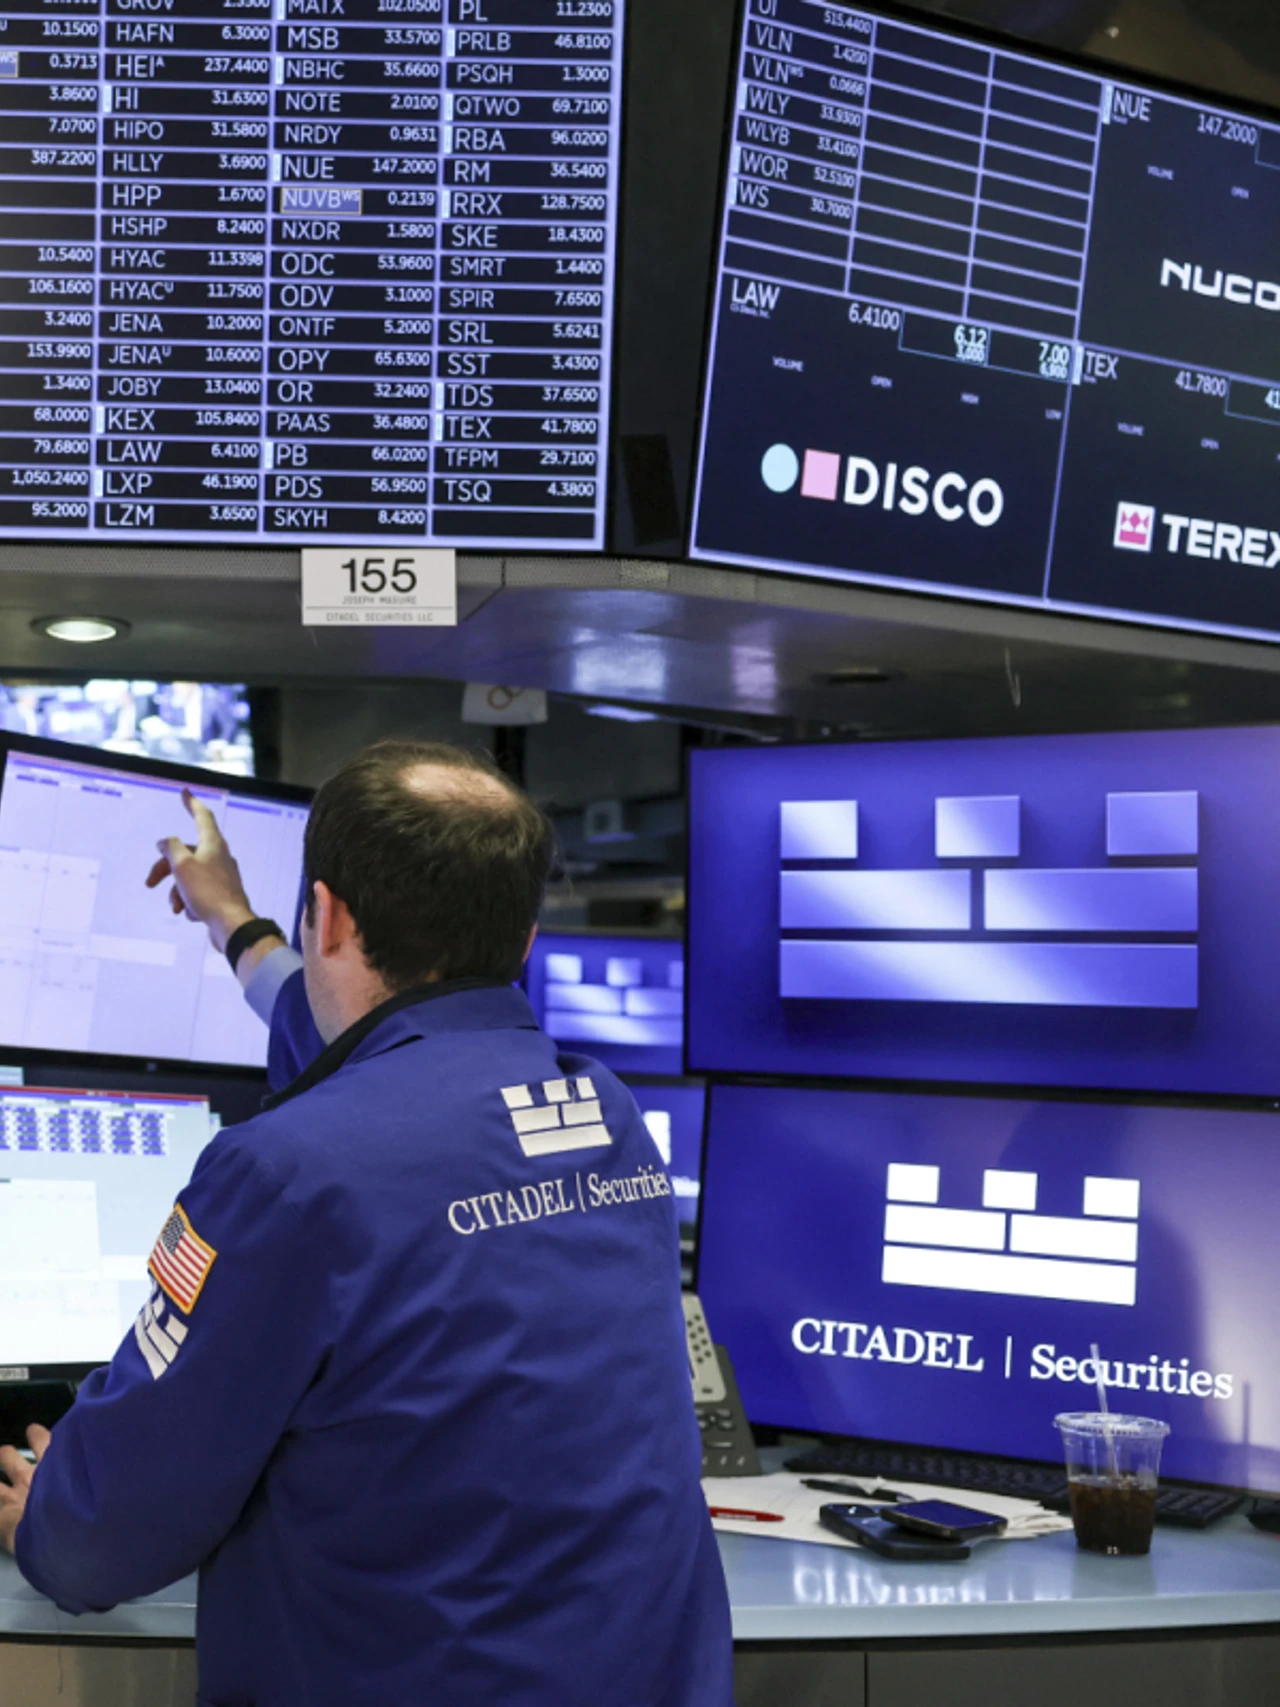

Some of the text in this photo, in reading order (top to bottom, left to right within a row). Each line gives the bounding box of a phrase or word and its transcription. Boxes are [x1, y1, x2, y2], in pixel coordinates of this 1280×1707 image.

[288, 26, 440, 50] MSB 33.5700
[756, 23, 793, 53] VLN
[457, 63, 611, 84] PSQH 1.3000
[749, 87, 790, 116] WLY
[50, 119, 97, 134] 7.0700
[1113, 90, 1257, 145] NUE 147.2000
[285, 124, 437, 144] NRDY 0.9631
[745, 118, 790, 146] WLYB
[113, 152, 266, 172] HLLY 3.6900
[742, 150, 788, 180] WOR
[739, 182, 770, 208] WS
[452, 224, 605, 248] SKE 18.4300
[111, 248, 264, 269] HYAC 11.3398
[29, 279, 93, 294] 106.1600
[280, 284, 432, 308] ODV 3.1000
[109, 313, 262, 333] JENA 10.2000
[449, 320, 601, 344] SRL 5.6241
[732, 277, 1069, 364] LAW 6.4100 6.12 7.00
[278, 348, 430, 372] OPY 65.6300
[44, 375, 91, 390] 1.3400
[1086, 351, 1227, 398] TEX 41.7800
[450, 384, 599, 407] TDS 37.6500
[108, 408, 259, 432] KEX 105.8400
[34, 439, 89, 454] 79.6800
[276, 443, 427, 467] PB 66.0200
[106, 470, 258, 495] LXP 46.1900
[448, 479, 595, 503] TSQ 4.3800
[843, 456, 1005, 527] DISCO
[274, 506, 425, 528] SKYH 8.4200
[341, 558, 417, 593] 155
[326, 612, 433, 622] CITADEL SECURITIES LLC
[447, 1165, 670, 1235] CITADEL Securities
[791, 1317, 1234, 1400] CITADEL Securities
